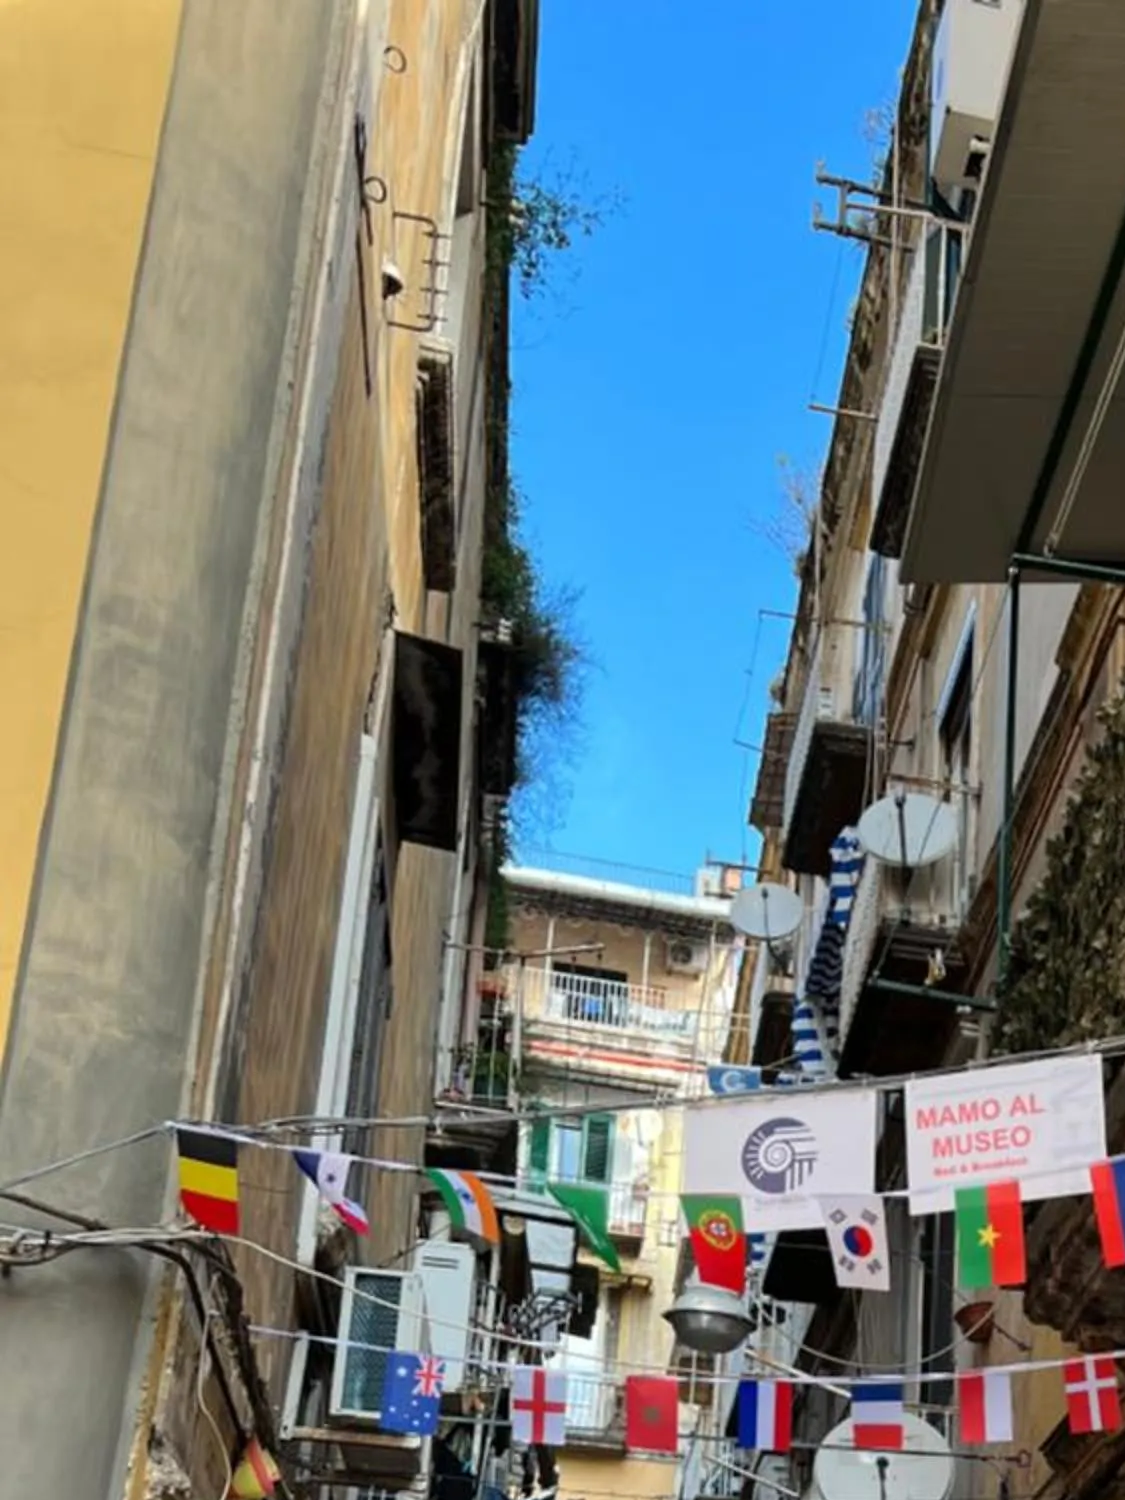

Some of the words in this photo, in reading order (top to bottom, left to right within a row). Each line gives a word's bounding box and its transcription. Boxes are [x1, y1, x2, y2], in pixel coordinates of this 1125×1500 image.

[916, 1098, 1001, 1130] MAMO
[1009, 1092, 1046, 1117] AL
[932, 1125, 1031, 1158] MUSEO
